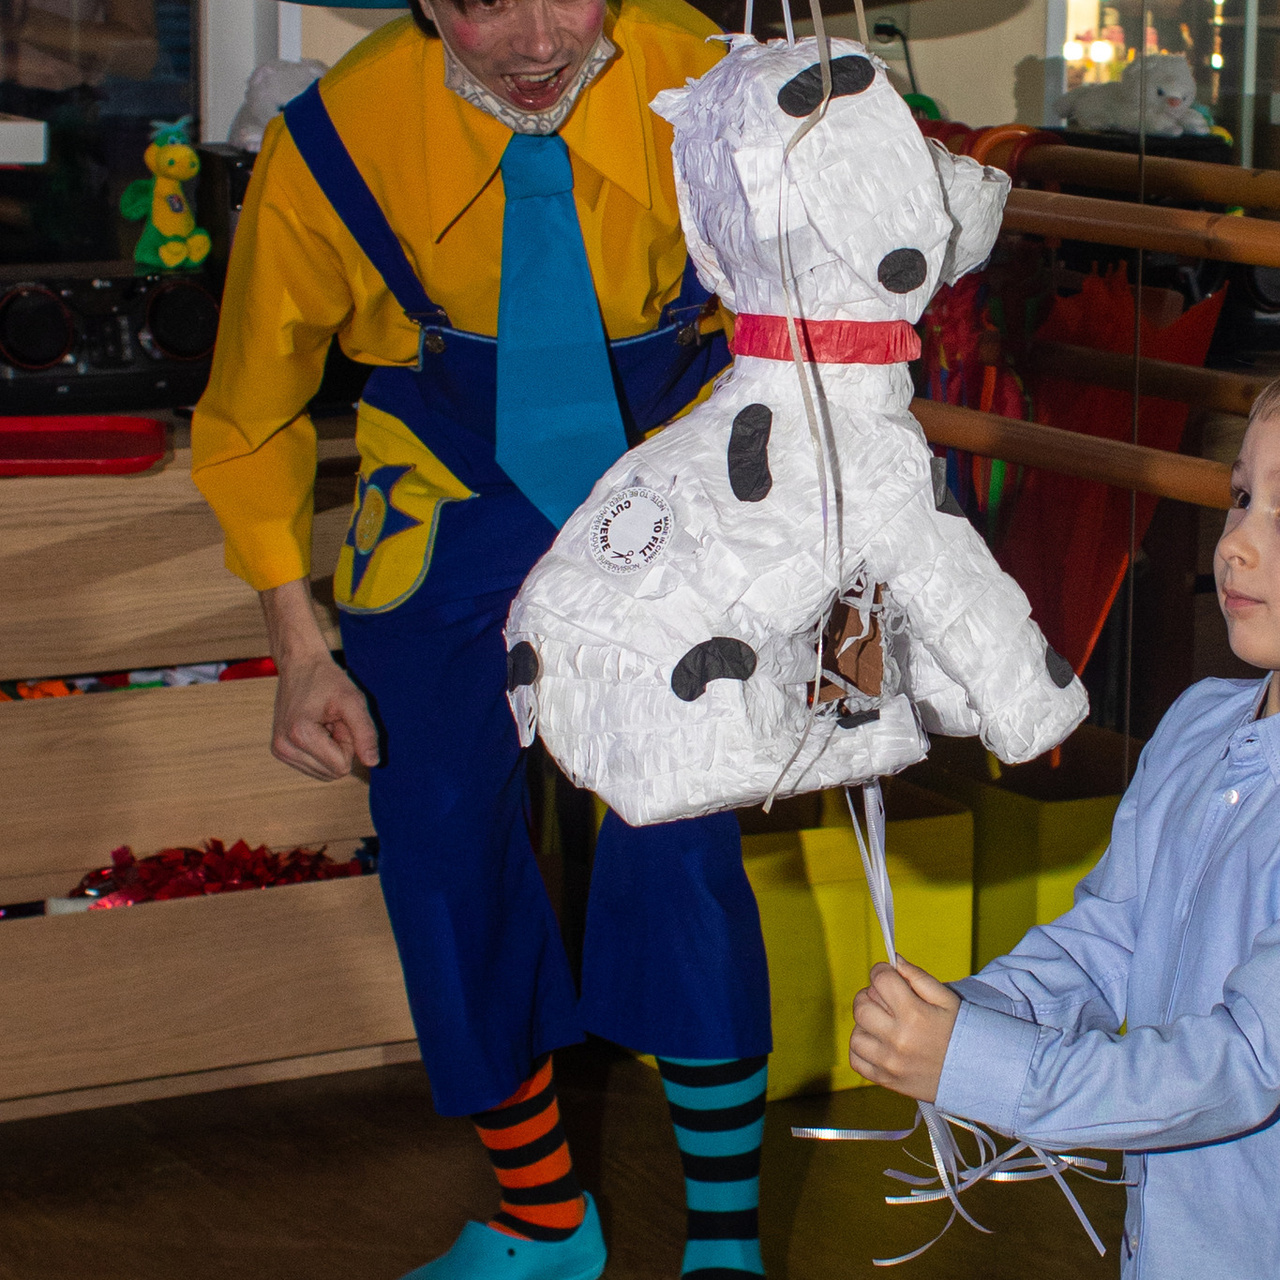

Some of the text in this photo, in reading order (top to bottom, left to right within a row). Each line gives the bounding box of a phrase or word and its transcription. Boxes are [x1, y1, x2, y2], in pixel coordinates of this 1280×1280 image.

[609, 491, 627, 507] USED
[639, 490, 648, 498] TO
[591, 505, 609, 530] UNDER
[600, 500, 631, 552] CUT HERE
[592, 532, 602, 555] ADULT
[639, 518, 663, 556] TO FILL
[659, 536, 665, 544] IN
[600, 554, 640, 571] SUPERVISION
[644, 544, 661, 563] CHINA
